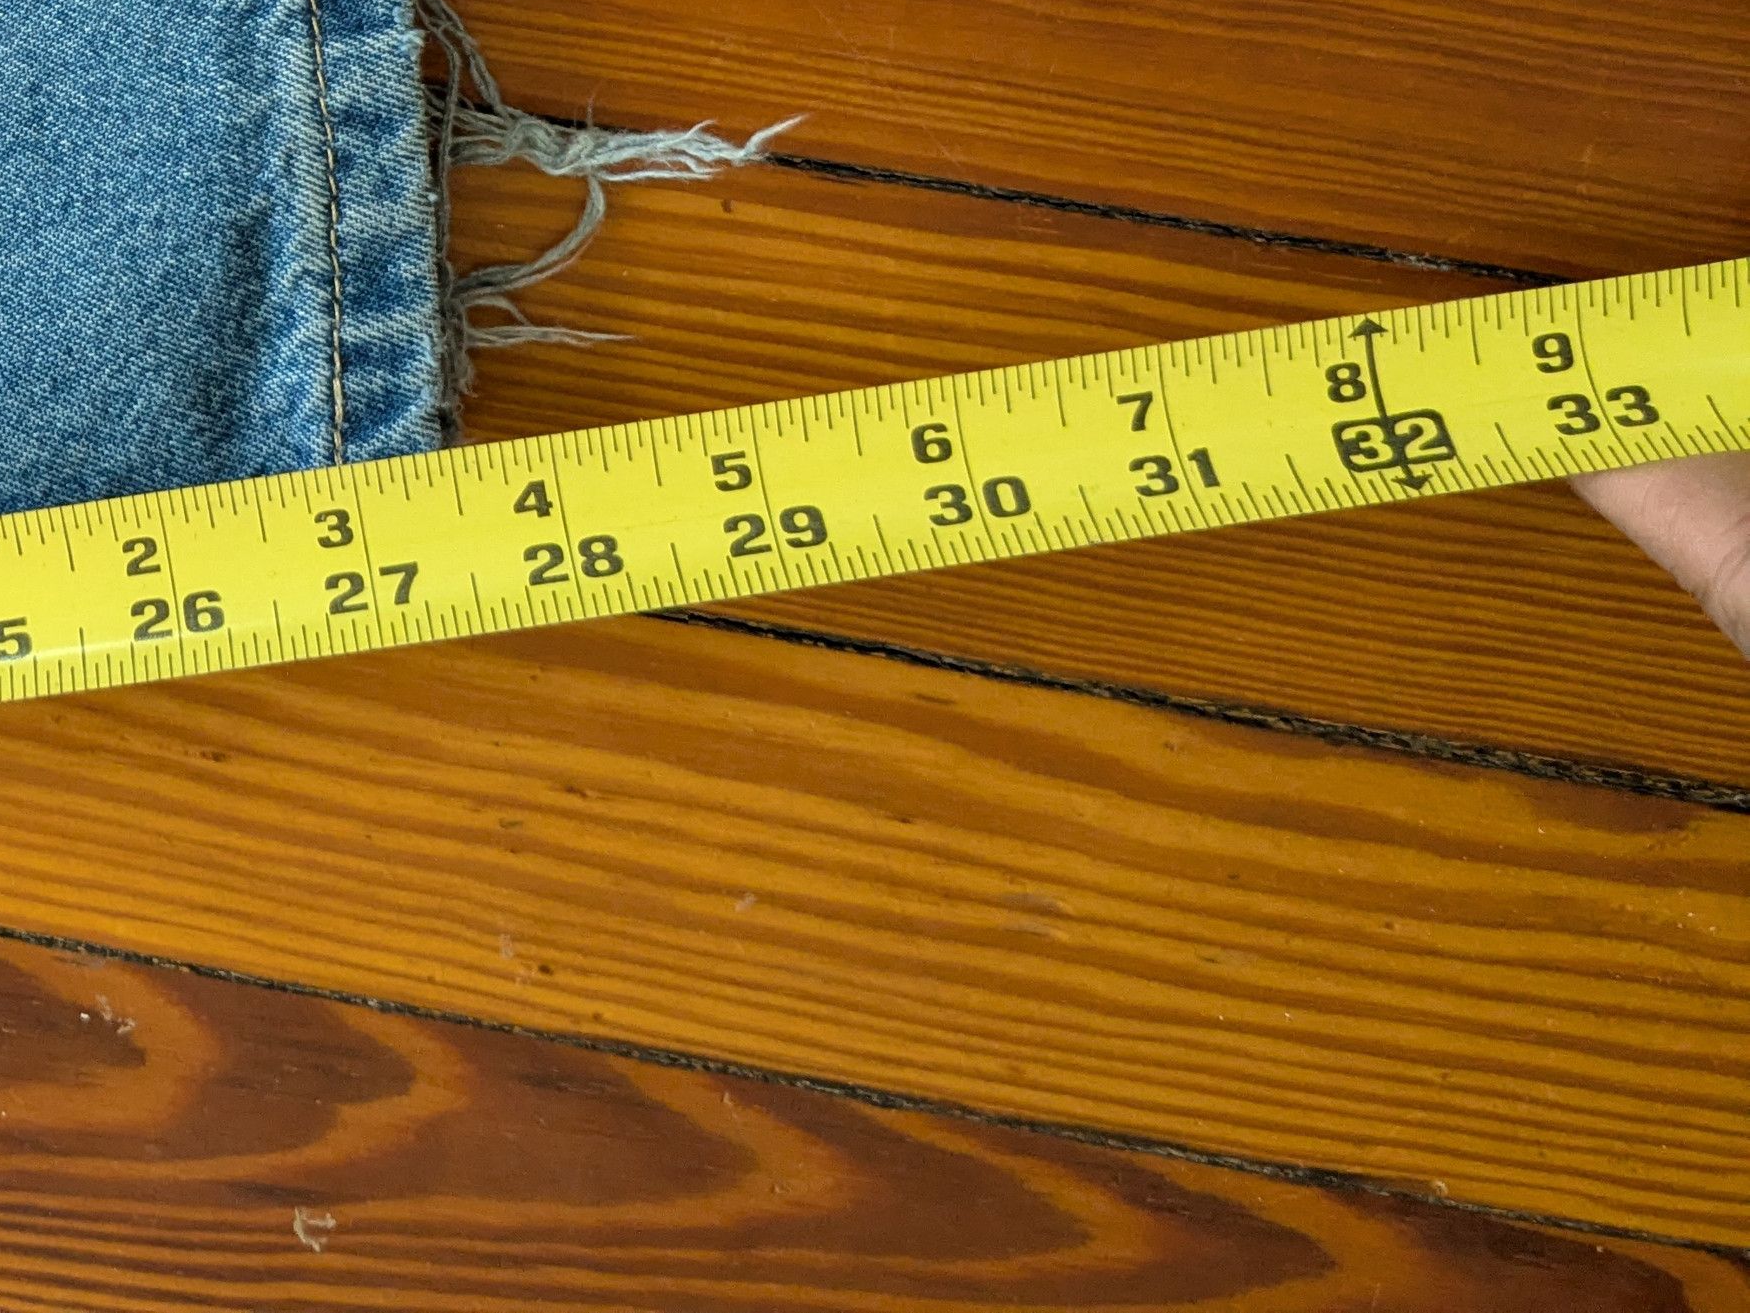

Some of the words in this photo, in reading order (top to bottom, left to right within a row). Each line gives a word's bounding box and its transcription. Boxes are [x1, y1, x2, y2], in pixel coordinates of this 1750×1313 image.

[123, 537, 160, 576] 2
[315, 509, 353, 548] 3
[513, 480, 553, 519] 4
[712, 450, 752, 492] 5
[912, 423, 952, 464] 6
[1117, 392, 1155, 432] 7
[1326, 363, 1367, 405] 8
[1532, 332, 1574, 375] 9
[131, 590, 224, 642] 26
[325, 562, 419, 615] 27
[523, 534, 624, 588] 28
[723, 504, 828, 558] 29
[923, 475, 1031, 527] 30
[1129, 447, 1221, 498] 31
[1339, 414, 1449, 467] 32
[1547, 384, 1660, 437] 33
